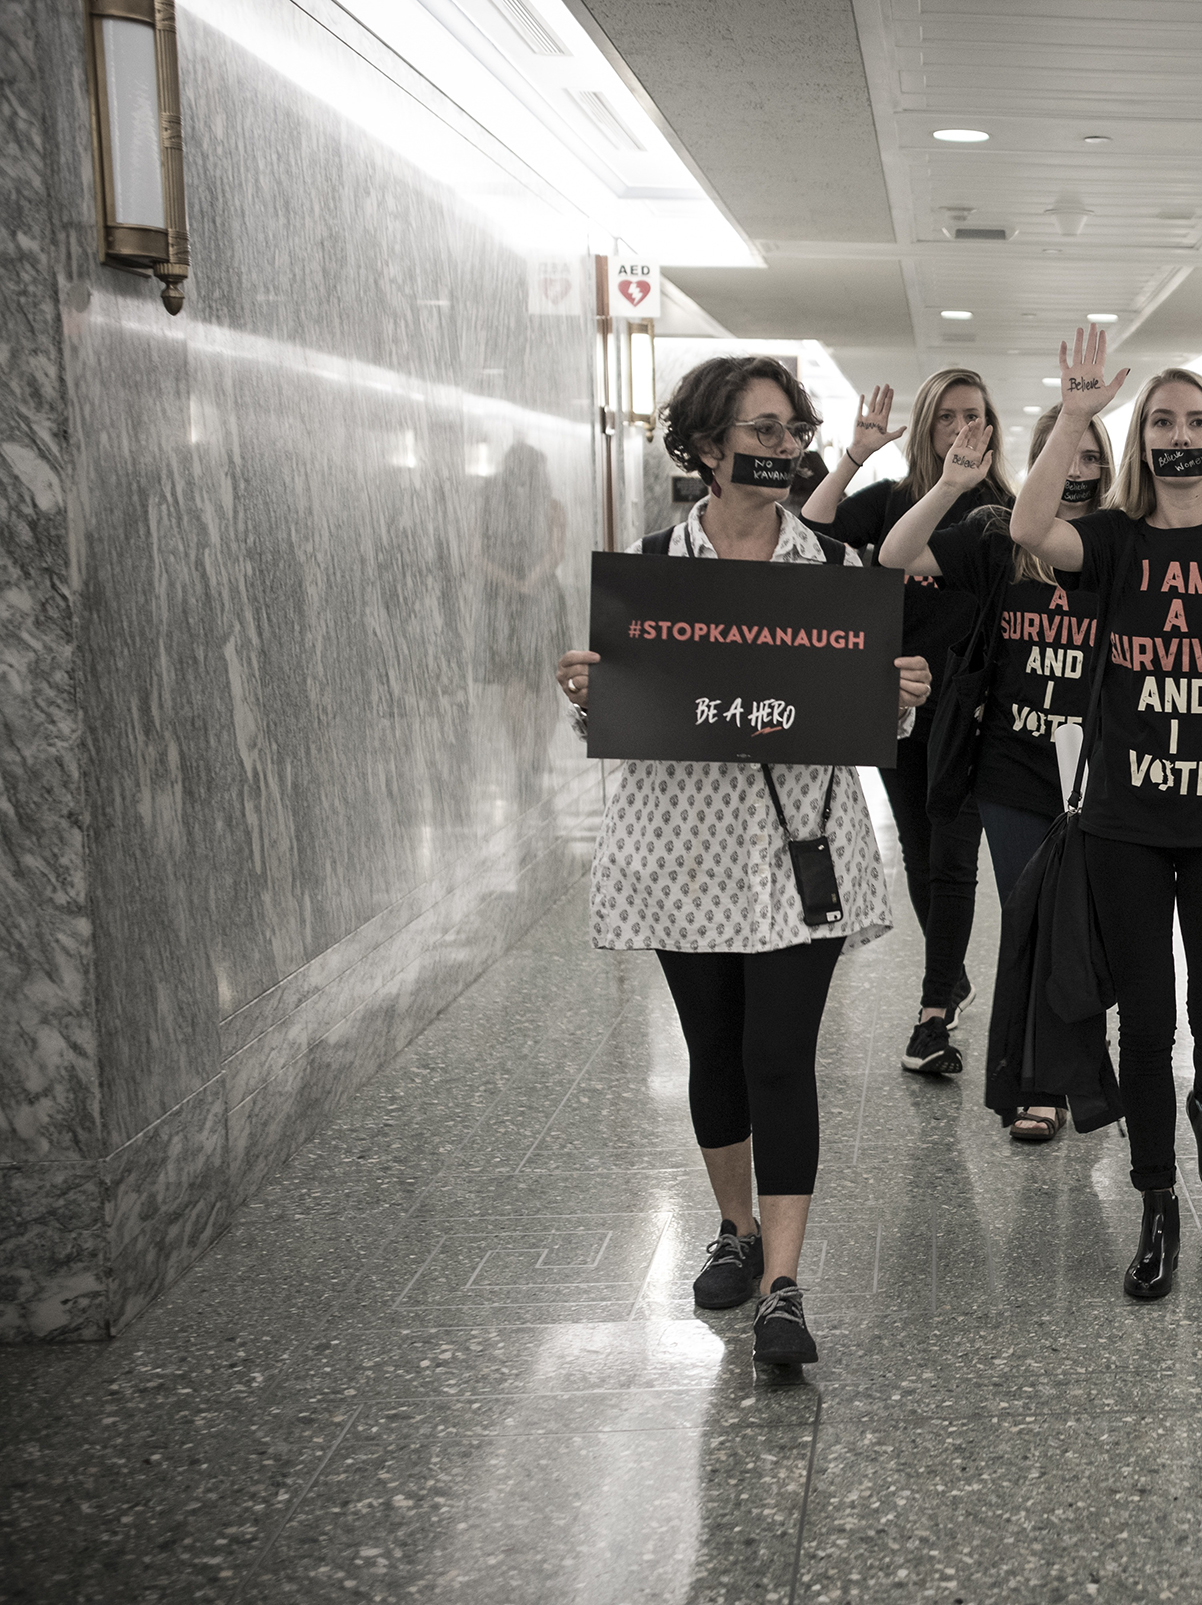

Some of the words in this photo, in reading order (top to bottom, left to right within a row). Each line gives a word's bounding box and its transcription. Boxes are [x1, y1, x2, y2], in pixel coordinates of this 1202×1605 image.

[618, 265, 651, 276] AED
[1067, 376, 1101, 392] Believe
[754, 459, 773, 469] NO
[1140, 559, 1150, 591] I
[1049, 586, 1070, 611] A
[1163, 599, 1188, 632] A
[628, 620, 865, 650] #STOPKAVANAUGH
[1025, 645, 1084, 680] AND
[1043, 680, 1055, 709] I
[695, 697, 723, 725] BE
[722, 698, 744, 728] A
[748, 698, 796, 730] HERO
[1169, 719, 1179, 754] I
